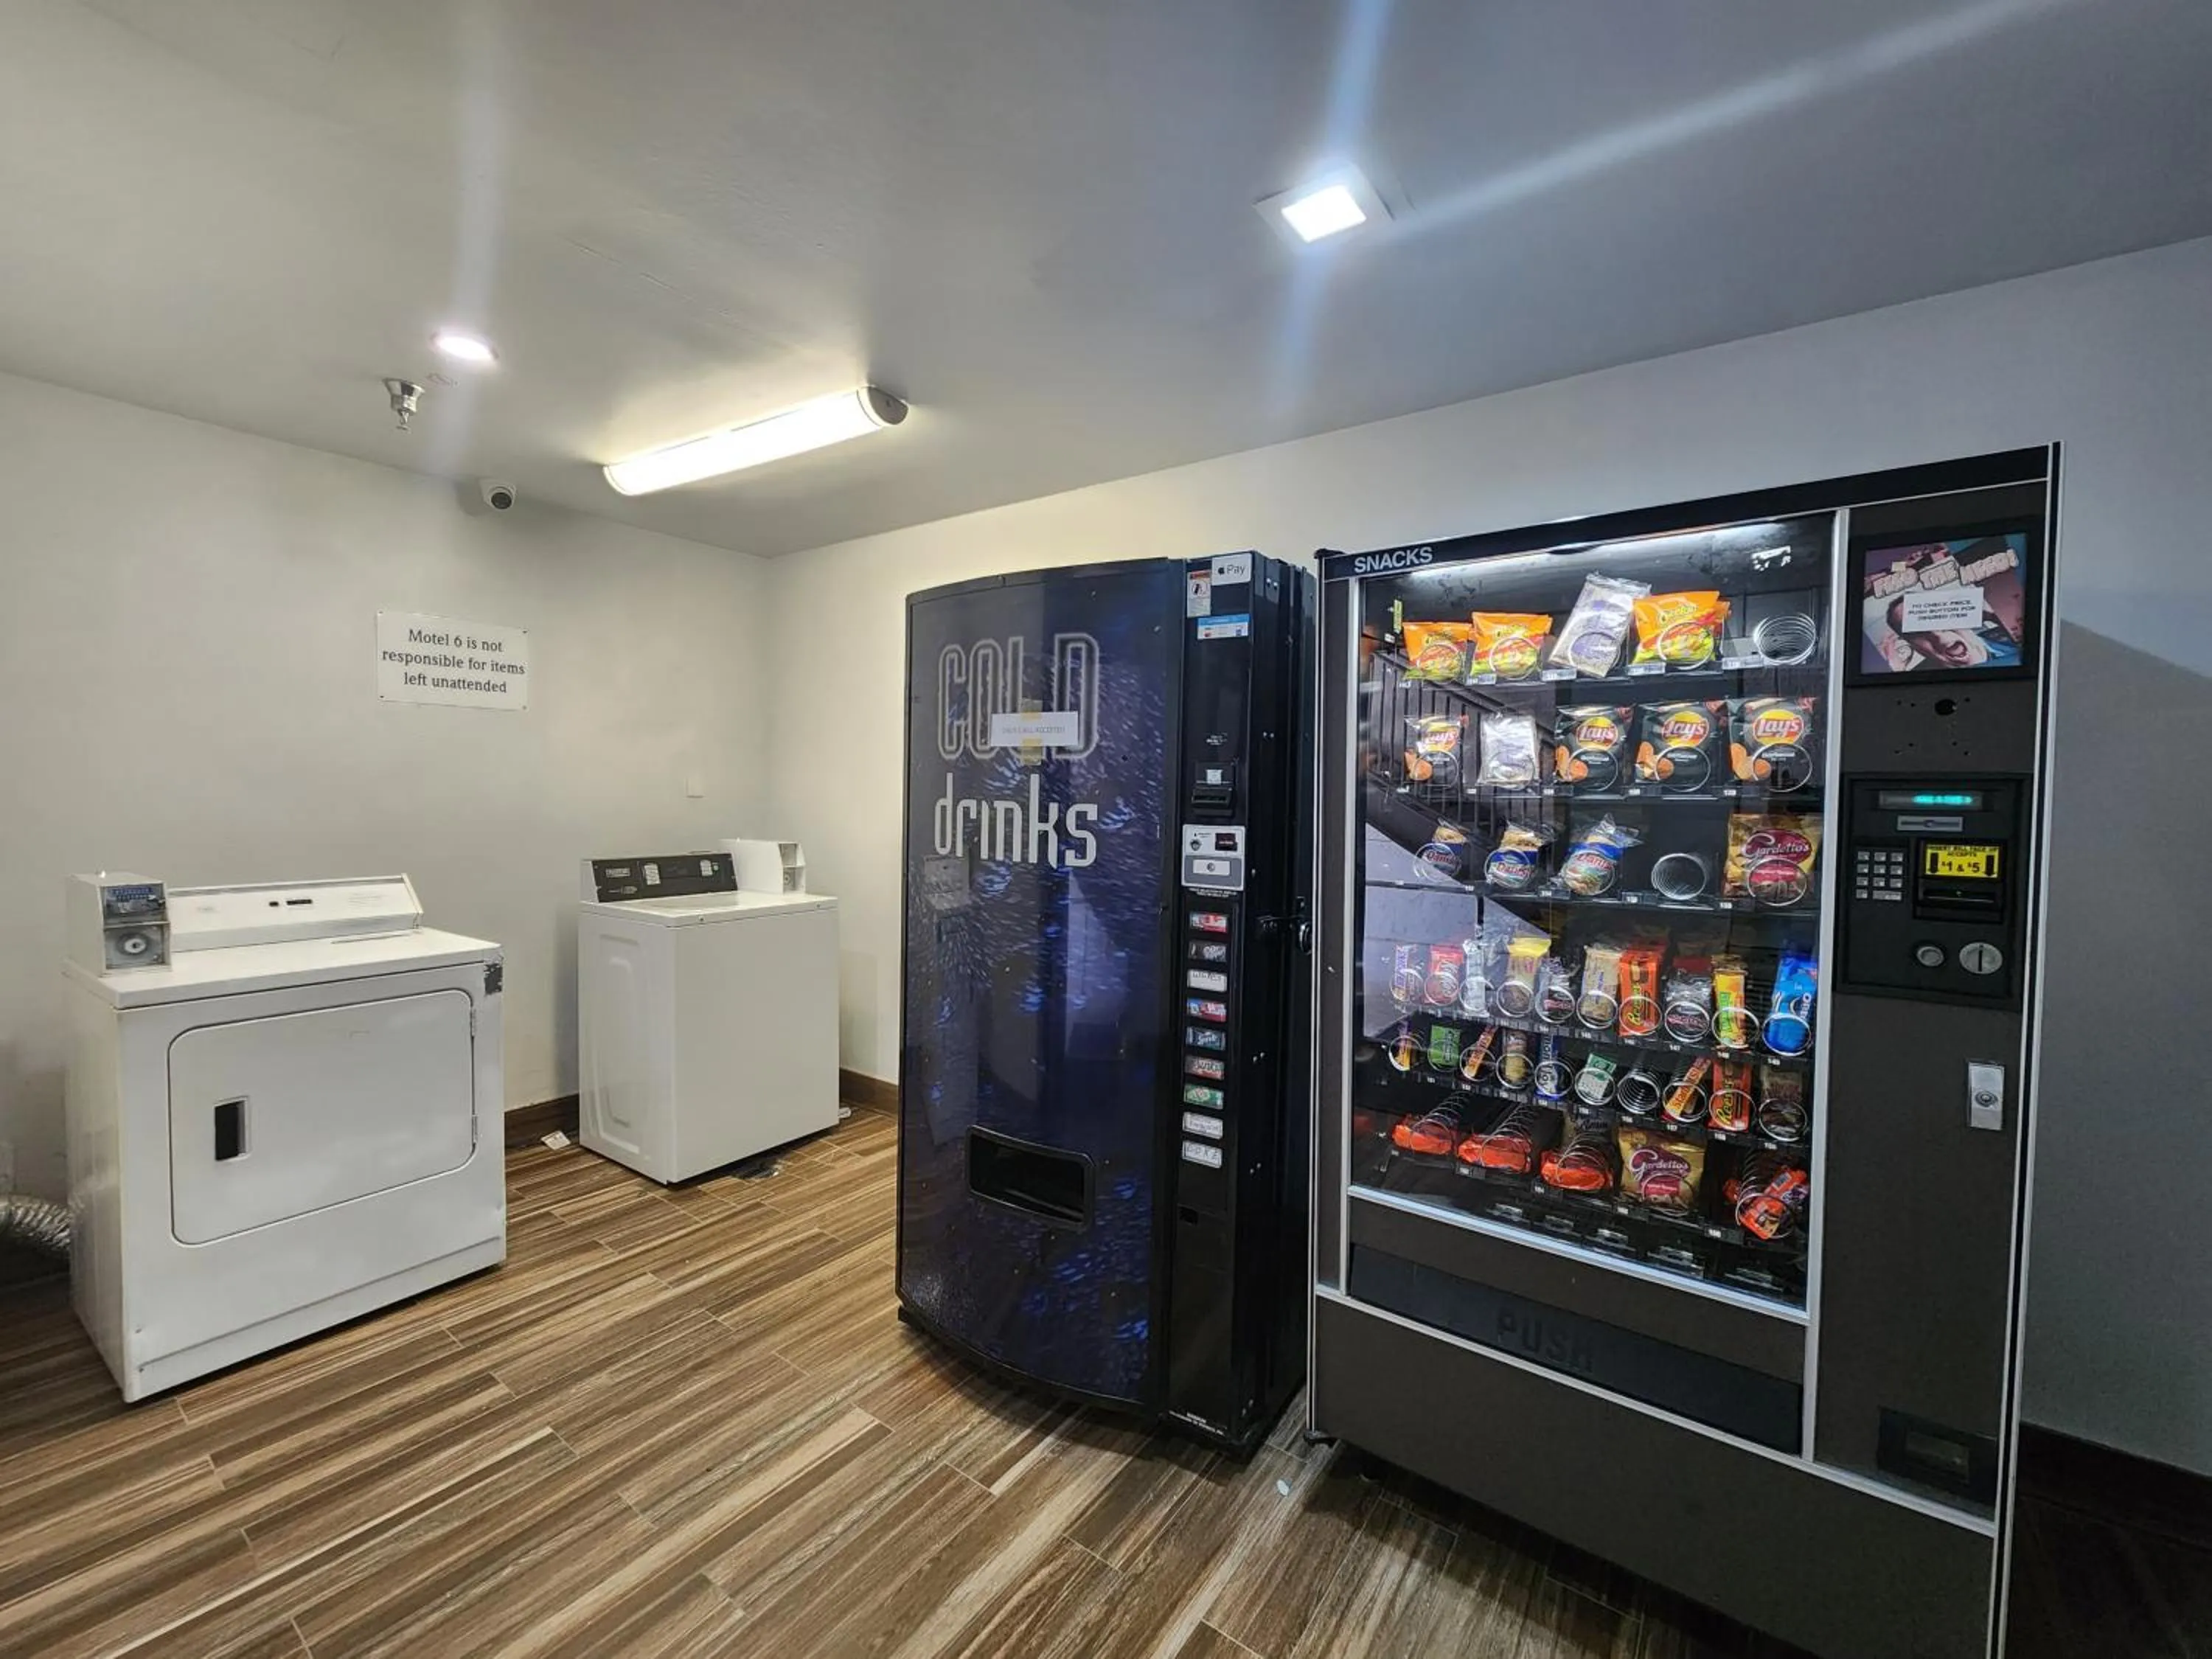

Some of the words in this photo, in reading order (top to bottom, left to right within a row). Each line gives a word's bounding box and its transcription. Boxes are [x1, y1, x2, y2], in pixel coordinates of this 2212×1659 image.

[1227, 564, 1246, 576] Pay
[1354, 546, 1433, 573] SNACKS
[408, 629, 449, 647] Motel
[454, 635, 462, 648] 6
[467, 636, 477, 650] is
[481, 639, 503, 653] not
[382, 650, 464, 669] responsible
[468, 657, 487, 671] for
[490, 660, 525, 675] items
[404, 672, 428, 686] left
[431, 675, 507, 694] unattended
[938, 633, 1099, 760] COLD
[934, 772, 1098, 869] drinks
[1957, 863, 1965, 872] &
[1497, 1307, 1593, 1372] PUSH
